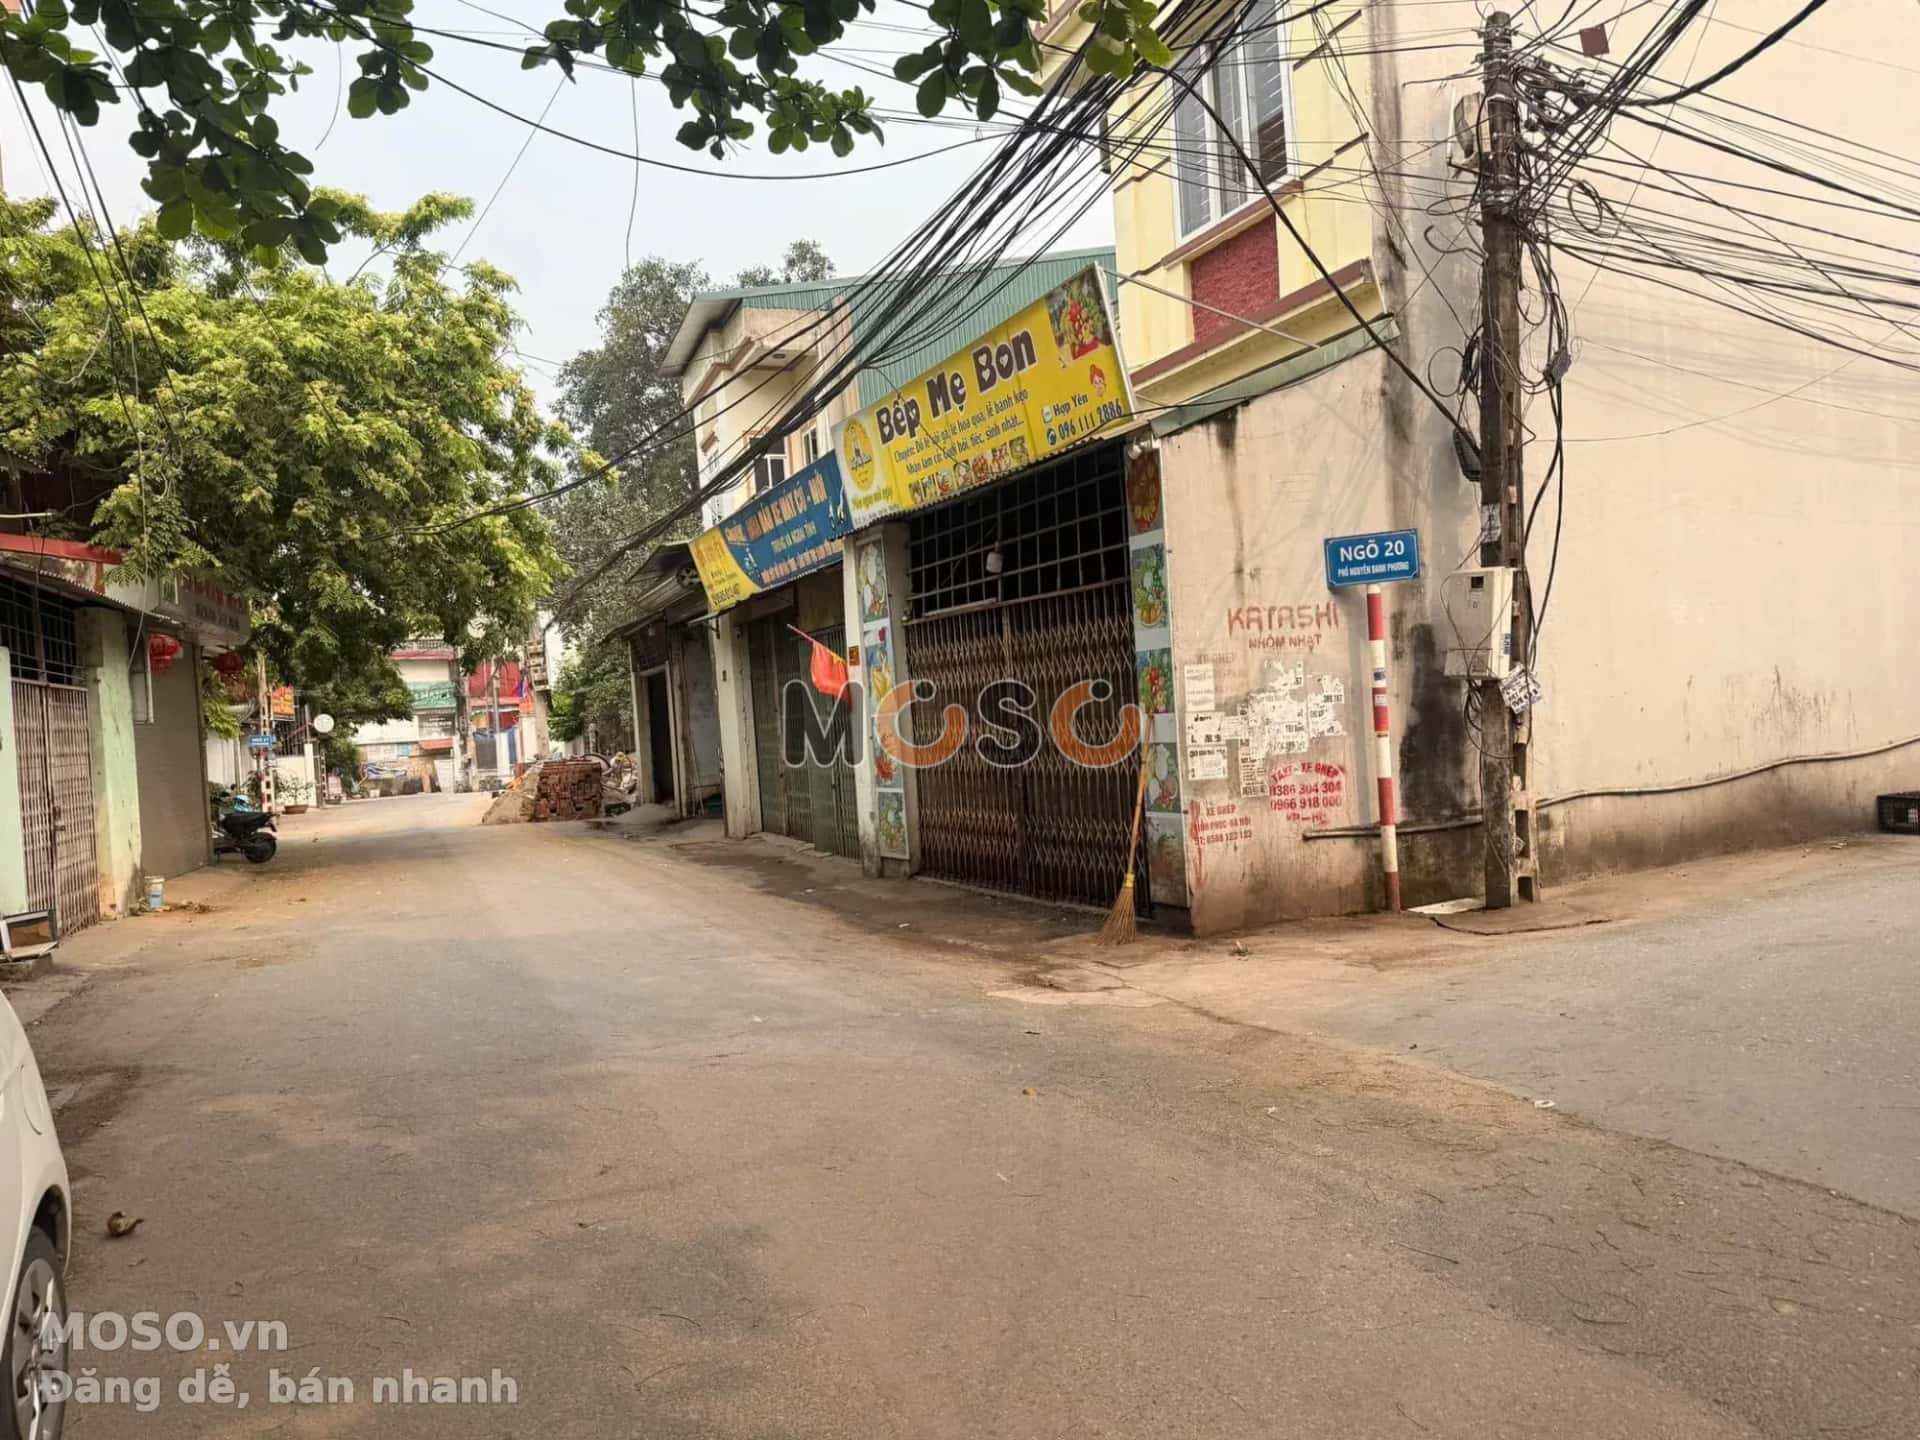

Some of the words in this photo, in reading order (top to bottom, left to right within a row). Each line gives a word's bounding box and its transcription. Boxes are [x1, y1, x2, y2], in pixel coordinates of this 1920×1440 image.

[876, 393, 921, 445] Bếp
[926, 371, 967, 419] Mẹ
[972, 331, 1037, 393] Bon
[1058, 419, 1076, 440] 096
[1079, 412, 1096, 432] 111
[1096, 398, 1123, 425] 2886
[1340, 538, 1379, 562] NGÕ
[1384, 540, 1405, 557] 20
[1228, 602, 1339, 638] KATASHI
[1300, 796, 1320, 809] 918
